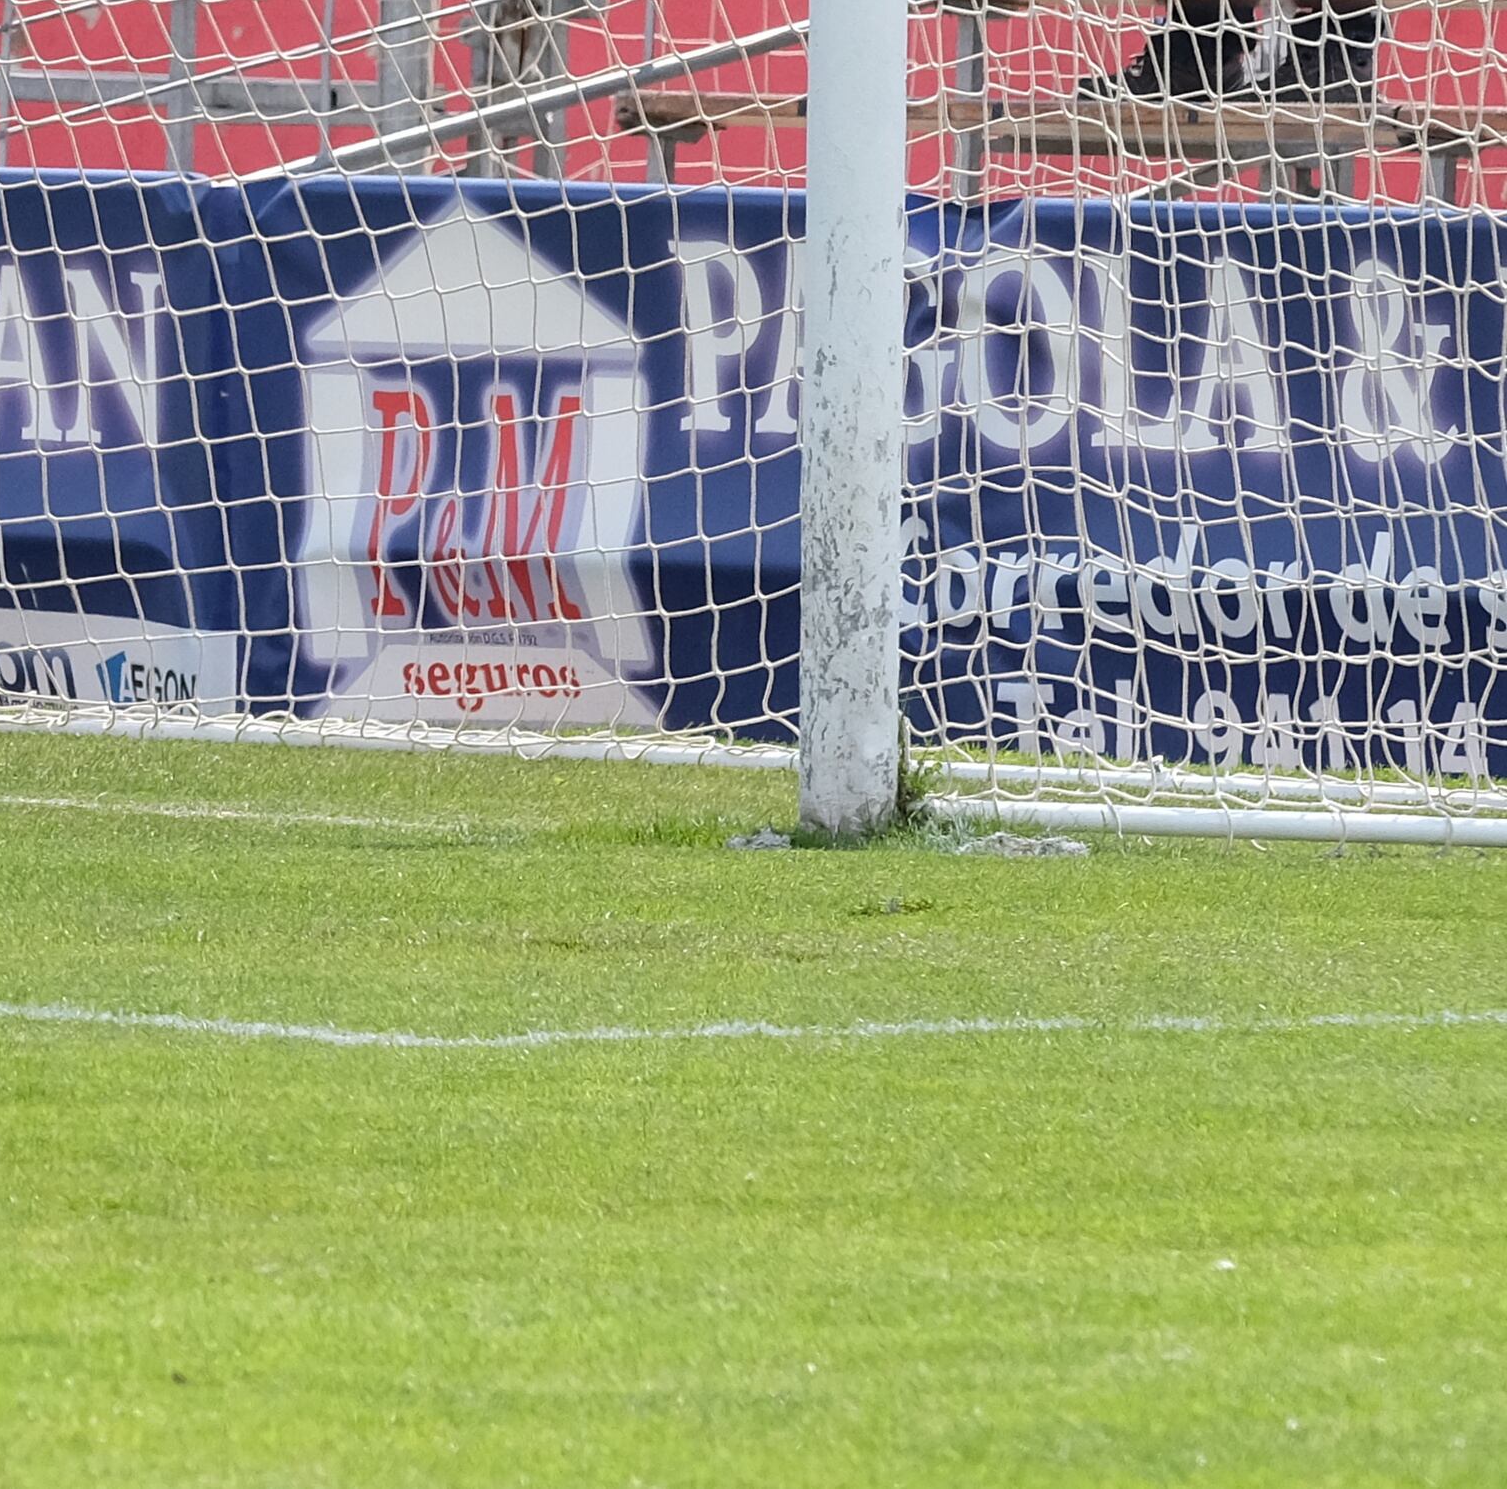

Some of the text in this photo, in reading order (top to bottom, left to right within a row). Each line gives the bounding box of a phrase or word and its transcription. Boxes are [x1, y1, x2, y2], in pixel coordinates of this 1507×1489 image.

[668, 240, 1284, 454] PGOLA
[1329, 531, 1451, 646] de
[403, 662, 581, 712] seguros
